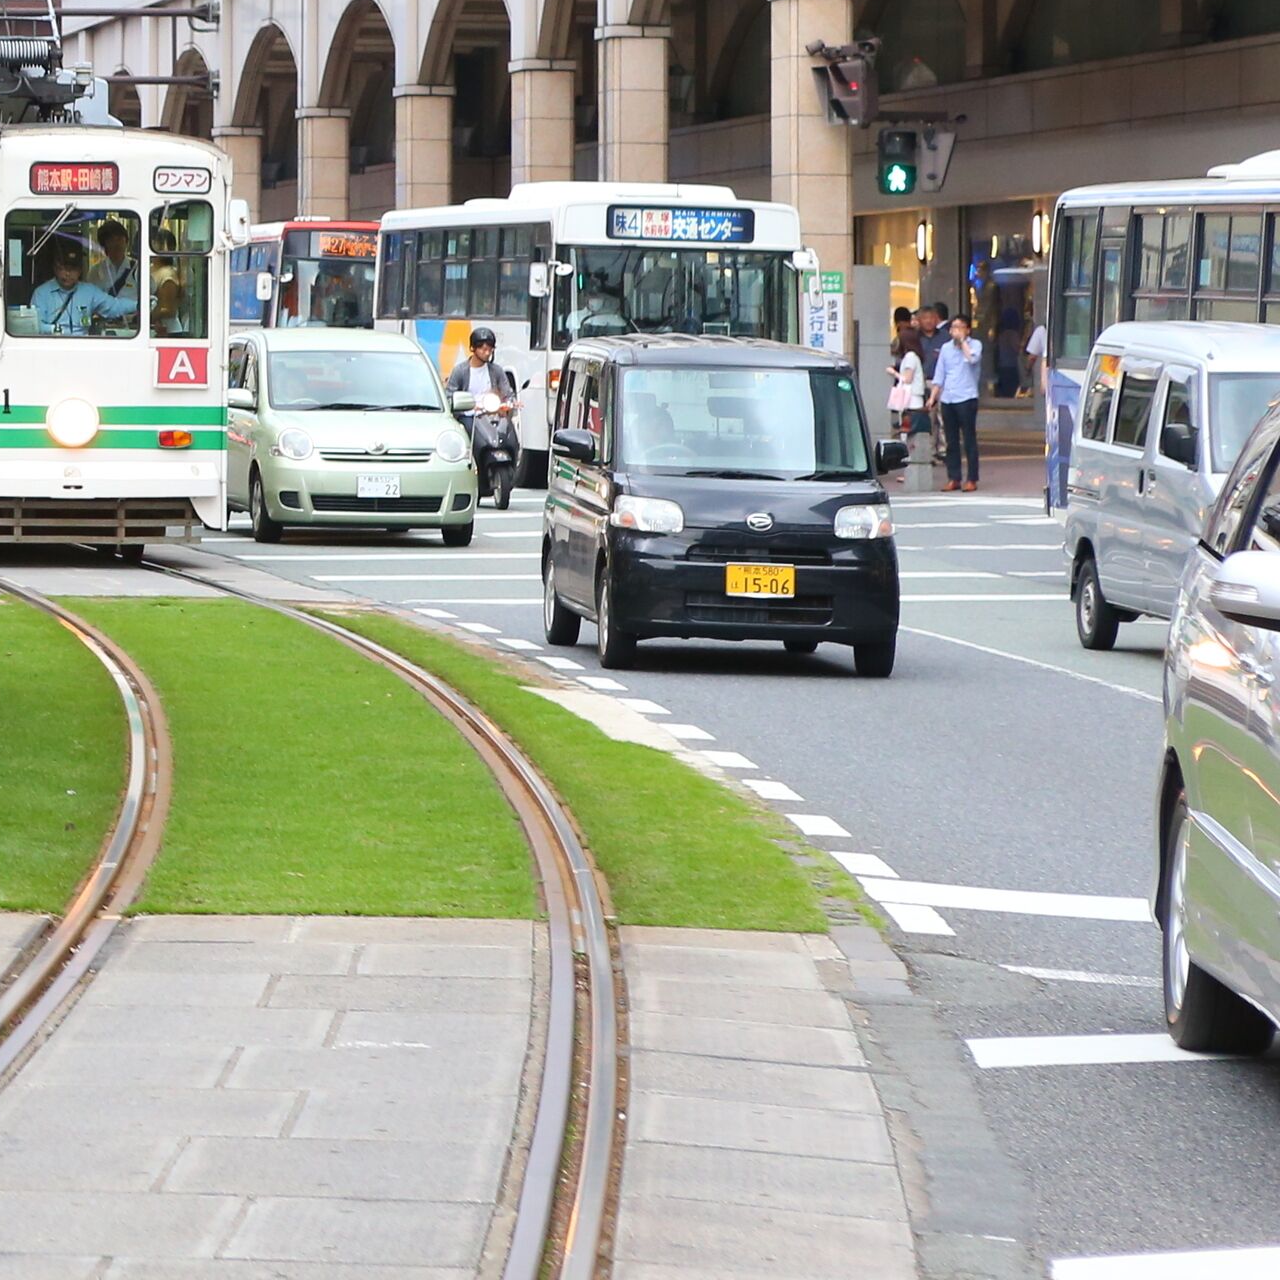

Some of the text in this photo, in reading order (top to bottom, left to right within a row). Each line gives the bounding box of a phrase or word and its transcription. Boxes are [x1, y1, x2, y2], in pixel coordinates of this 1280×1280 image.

[36, 167, 114, 192] 熊本駅・田崎橋
[156, 173, 208, 188] ワンマン
[615, 211, 639, 234] 味4
[672, 217, 744, 240] 交通センター
[168, 350, 196, 381] A
[744, 577, 790, 595] 15-06
